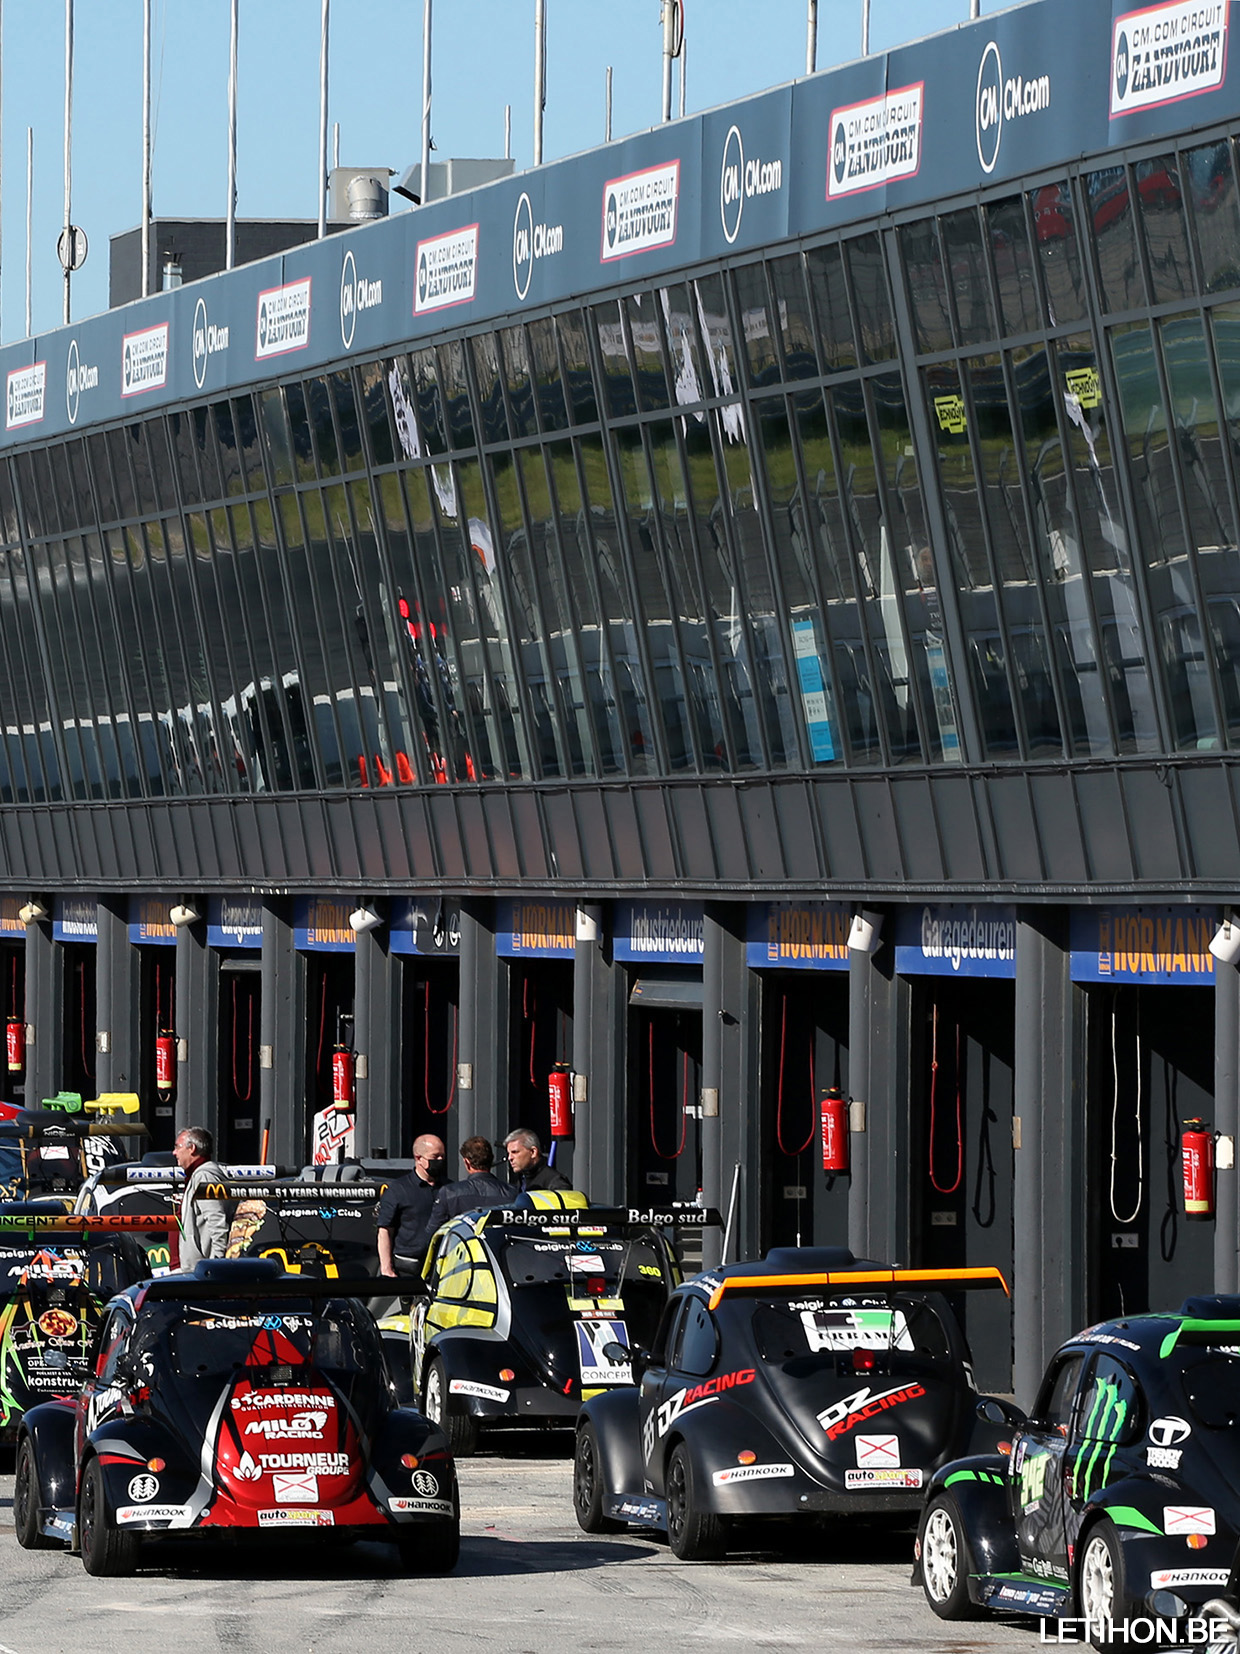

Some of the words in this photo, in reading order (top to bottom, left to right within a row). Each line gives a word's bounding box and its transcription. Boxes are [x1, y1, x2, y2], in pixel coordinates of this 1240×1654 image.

[1132, 21, 1179, 48] CM.COM
[1180, 5, 1222, 36] CIRCUIT
[1131, 31, 1221, 94] ZANDVOORT
[1004, 74, 1050, 121] CM.com
[847, 112, 884, 136] CM.COM
[883, 101, 918, 125] CIRCUIT
[847, 124, 916, 178] ZANDVOORT
[646, 176, 674, 197] CIRCUIT
[744, 158, 782, 198] CM.com
[618, 199, 674, 243] ZANDVOORT
[533, 223, 563, 259] CM.com
[357, 279, 382, 312] CM.com
[921, 906, 1015, 971] Garagedeuren
[230, 1188, 247, 1197] BIG
[289, 1188, 318, 1197] YEARS
[320, 1188, 376, 1197] UNCHANGED
[65, 1217, 104, 1226] CAR
[110, 1216, 168, 1226] CLEAN
[279, 1208, 318, 1217] Belgian
[337, 1208, 362, 1217] Club
[502, 1209, 549, 1227] Belgo
[551, 1209, 580, 1225] sud
[628, 1209, 675, 1227] Belgo
[677, 1208, 708, 1224] sud
[582, 1371, 631, 1380] CONCEPT
[682, 1369, 757, 1407] RACING
[826, 1382, 927, 1441] RACING
[265, 1431, 323, 1440] RACING
[258, 1453, 349, 1468] TOURNEUR
[306, 1466, 350, 1475] GROUPE
